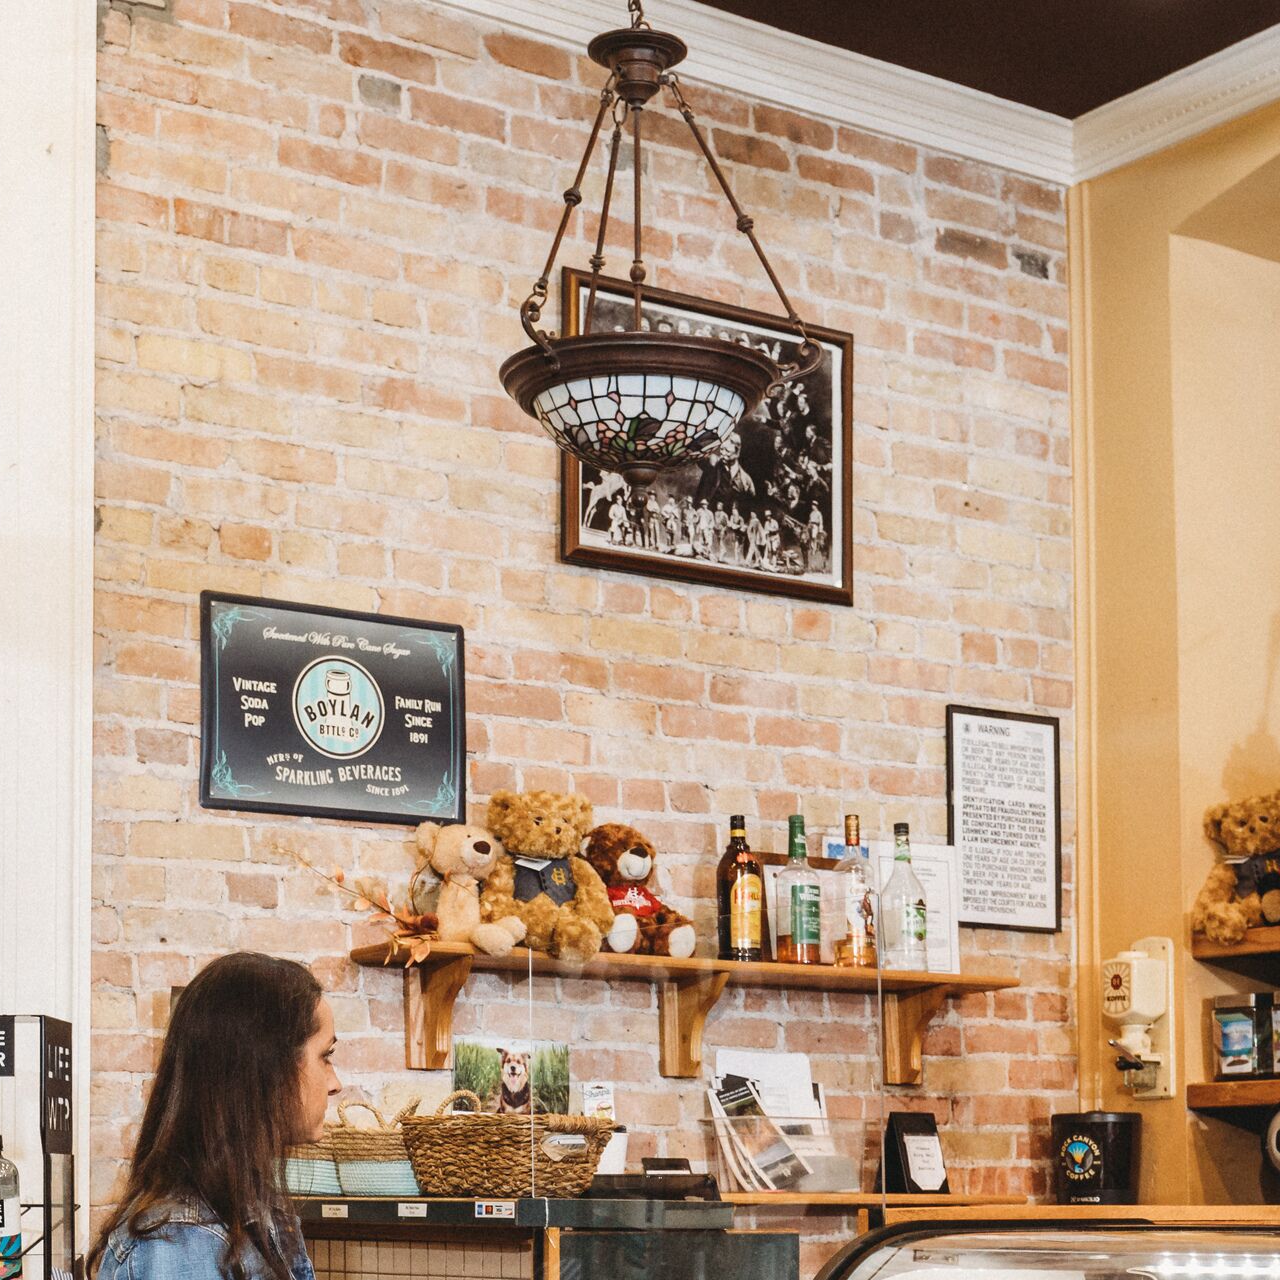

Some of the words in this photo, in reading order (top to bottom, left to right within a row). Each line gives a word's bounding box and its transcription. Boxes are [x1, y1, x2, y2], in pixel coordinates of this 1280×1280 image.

[331, 635, 355, 649] Pure
[240, 695, 269, 711] SODA
[303, 699, 375, 729] BOYLAN
[404, 713, 433, 729] SINCE
[409, 732, 429, 744] 1891
[977, 724, 1010, 737] WARNING
[275, 765, 334, 786] SPARKLING
[337, 764, 402, 782] BEVERAGES
[365, 784, 391, 797] SINCE
[391, 785, 410, 796] 1891
[48, 1044, 70, 1081] LIFE
[1072, 1135, 1101, 1156] CANYON
[1066, 1168, 1096, 1181] COFFEE
